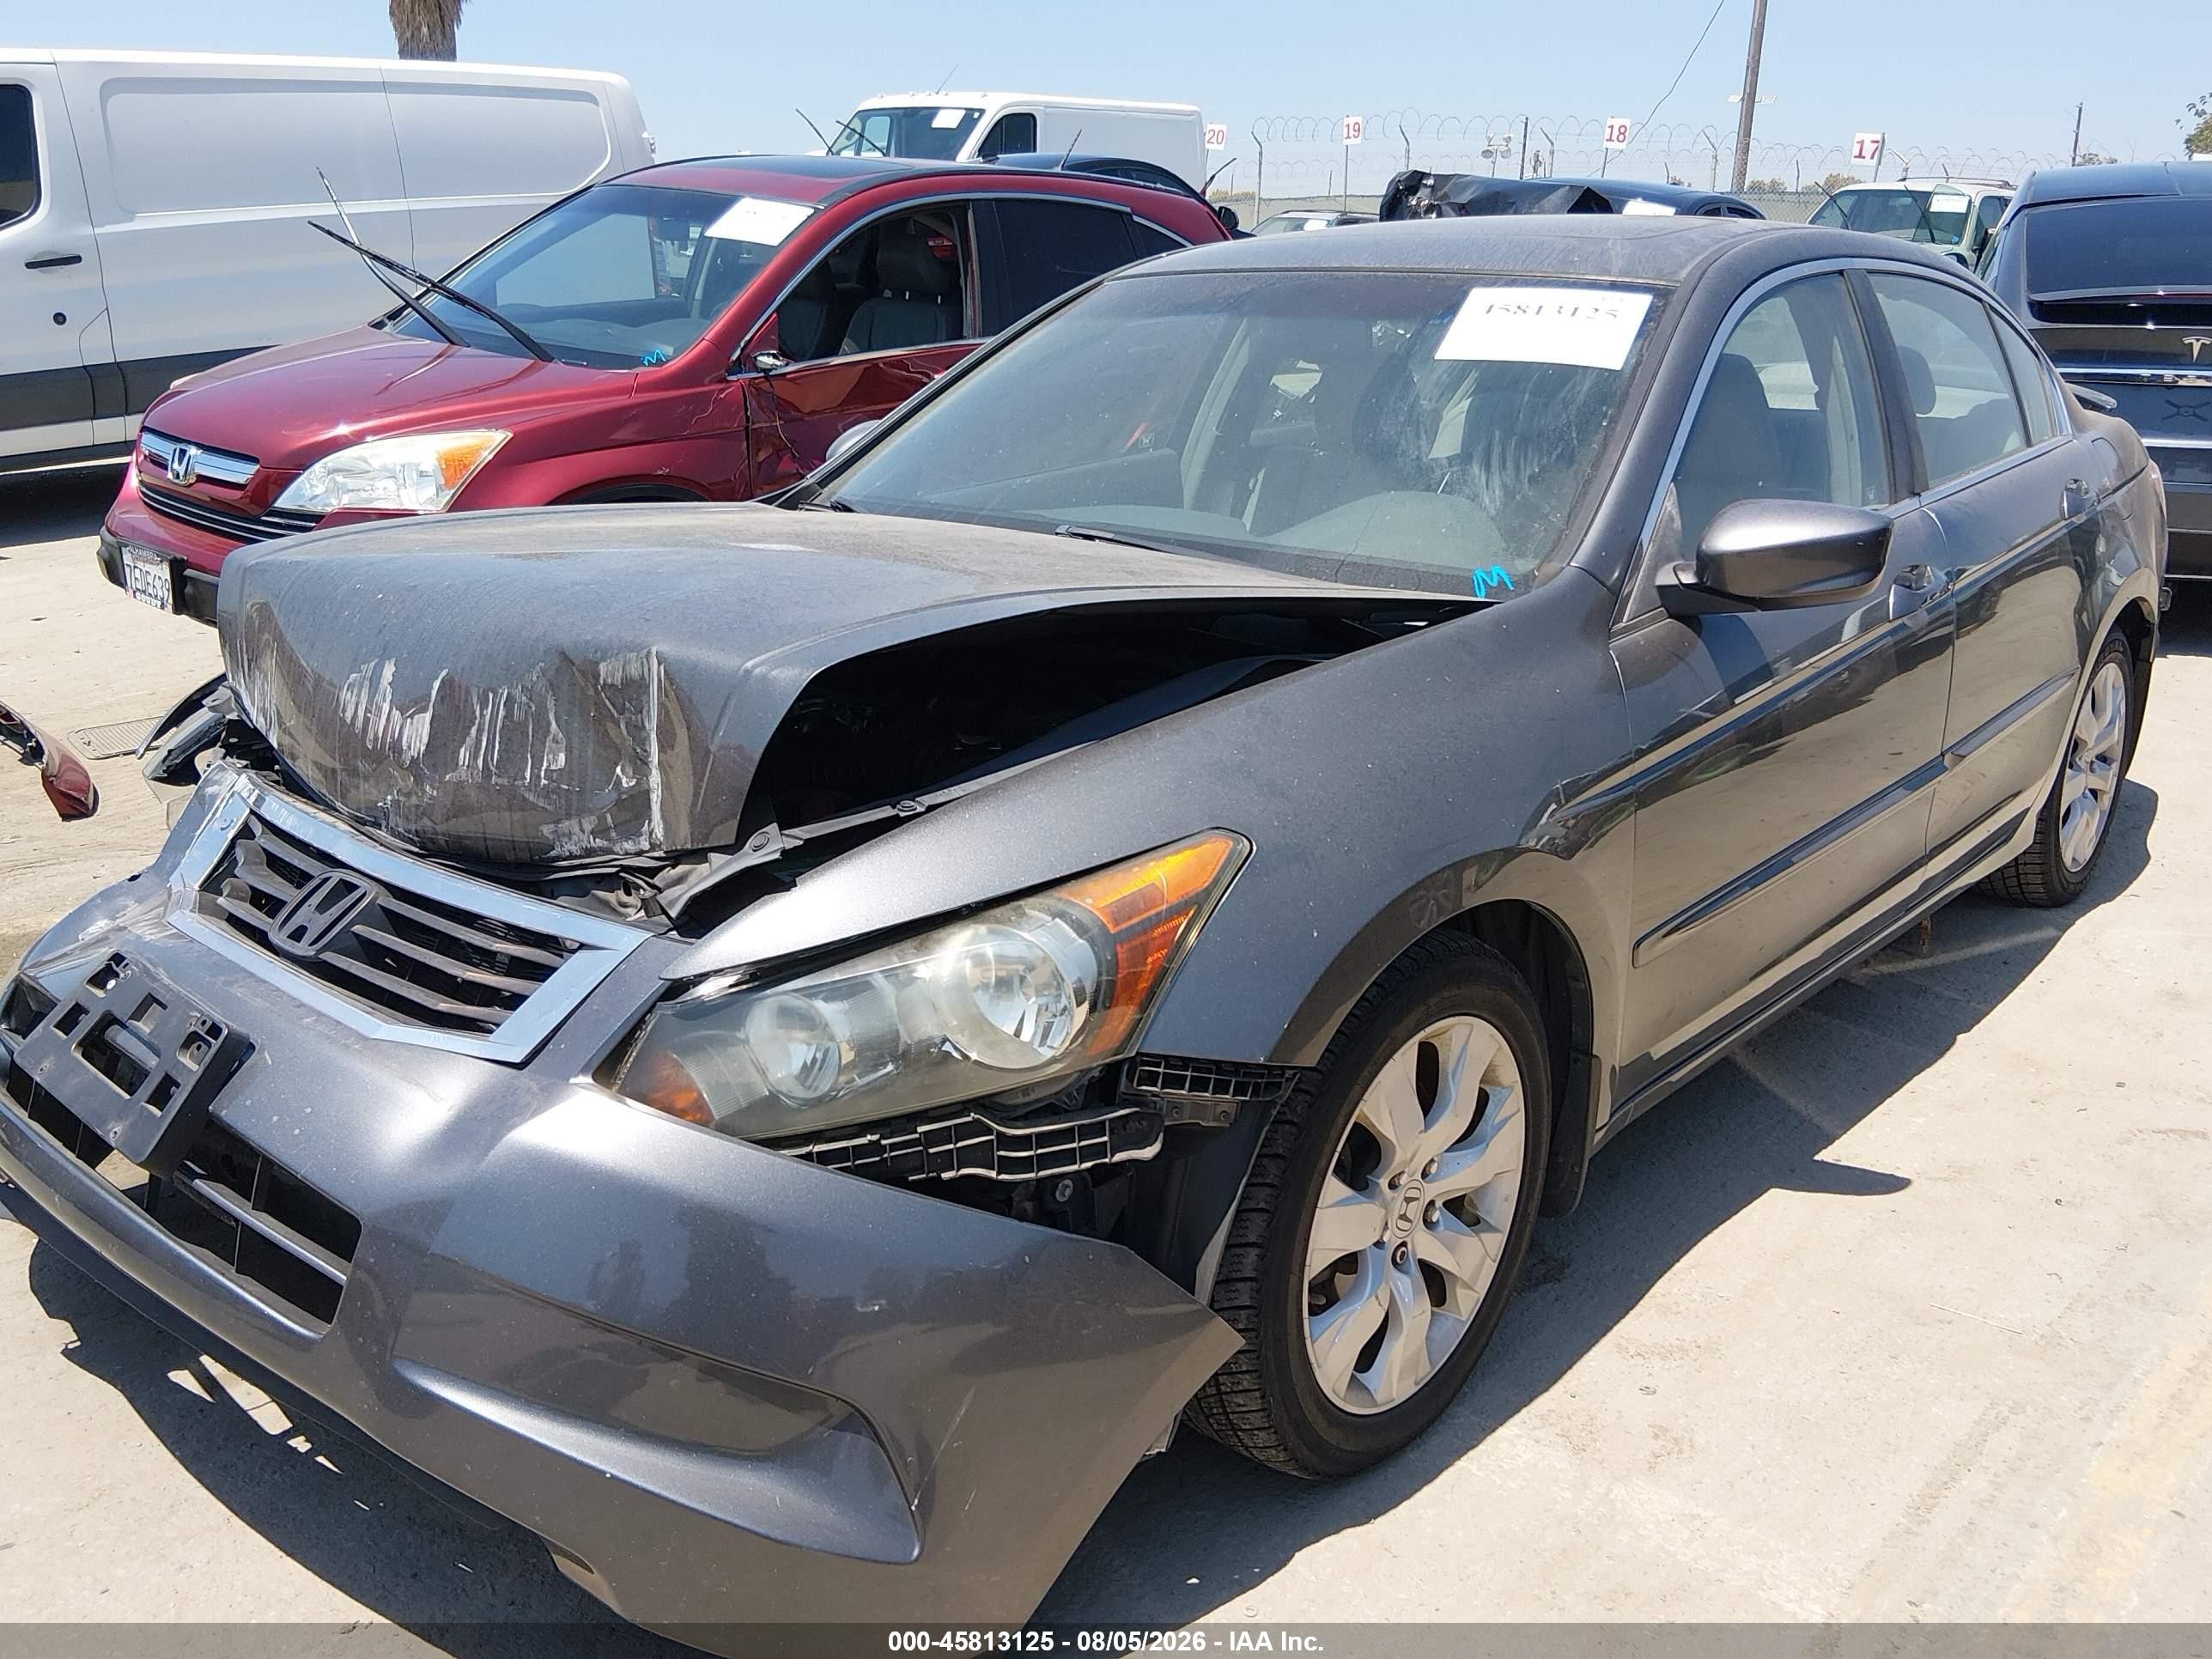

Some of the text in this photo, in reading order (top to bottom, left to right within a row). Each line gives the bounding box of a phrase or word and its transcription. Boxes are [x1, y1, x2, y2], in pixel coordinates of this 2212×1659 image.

[1206, 129, 1224, 145] 20
[1345, 122, 1361, 139] 19
[1606, 124, 1628, 143] 18
[1853, 138, 1881, 161] 17
[125, 562, 171, 605] 7EDE639
